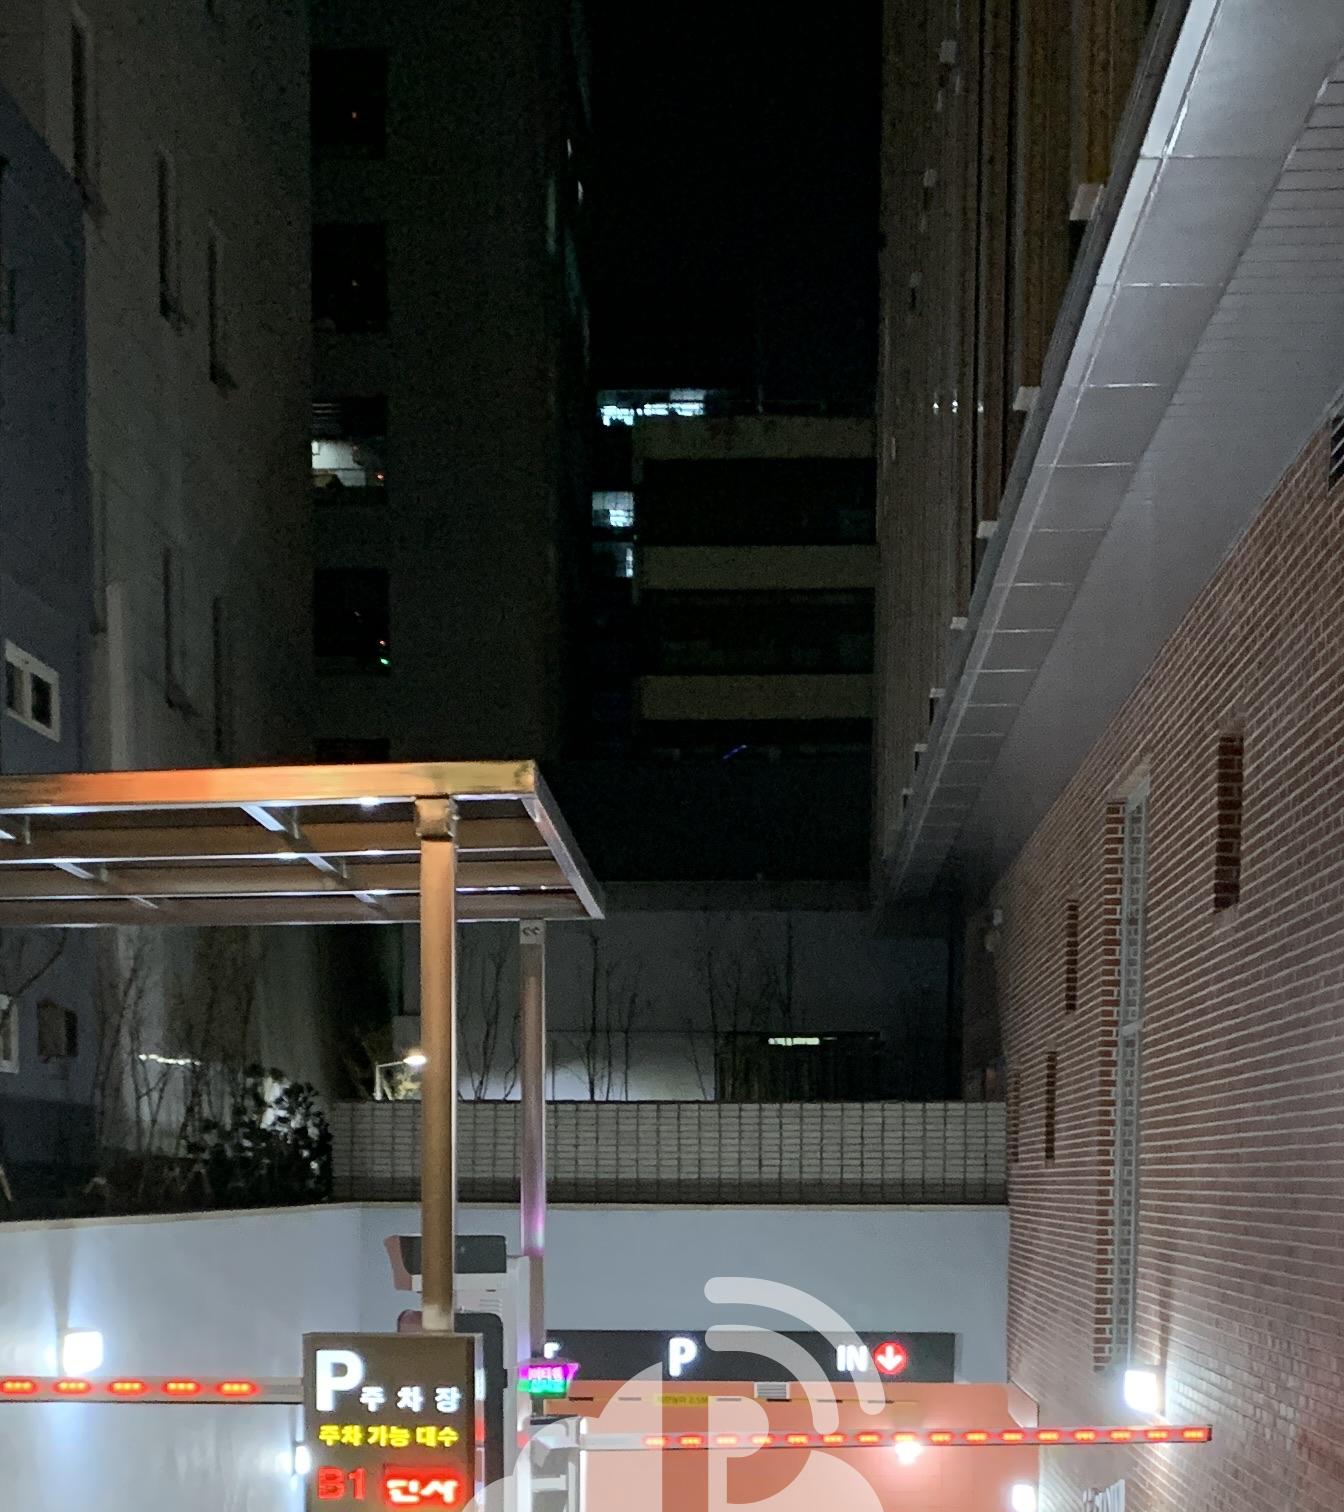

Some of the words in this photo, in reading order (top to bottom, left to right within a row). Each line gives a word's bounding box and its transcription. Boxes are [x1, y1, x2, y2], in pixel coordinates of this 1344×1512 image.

[669, 1337, 697, 1377] P
[836, 1344, 869, 1372] IN
[316, 1350, 365, 1412] P
[359, 1386, 462, 1413] 주차장
[318, 1424, 363, 1447] 주차
[367, 1424, 411, 1448] 가능
[415, 1425, 459, 1448] 대수
[317, 1466, 367, 1500] B1
